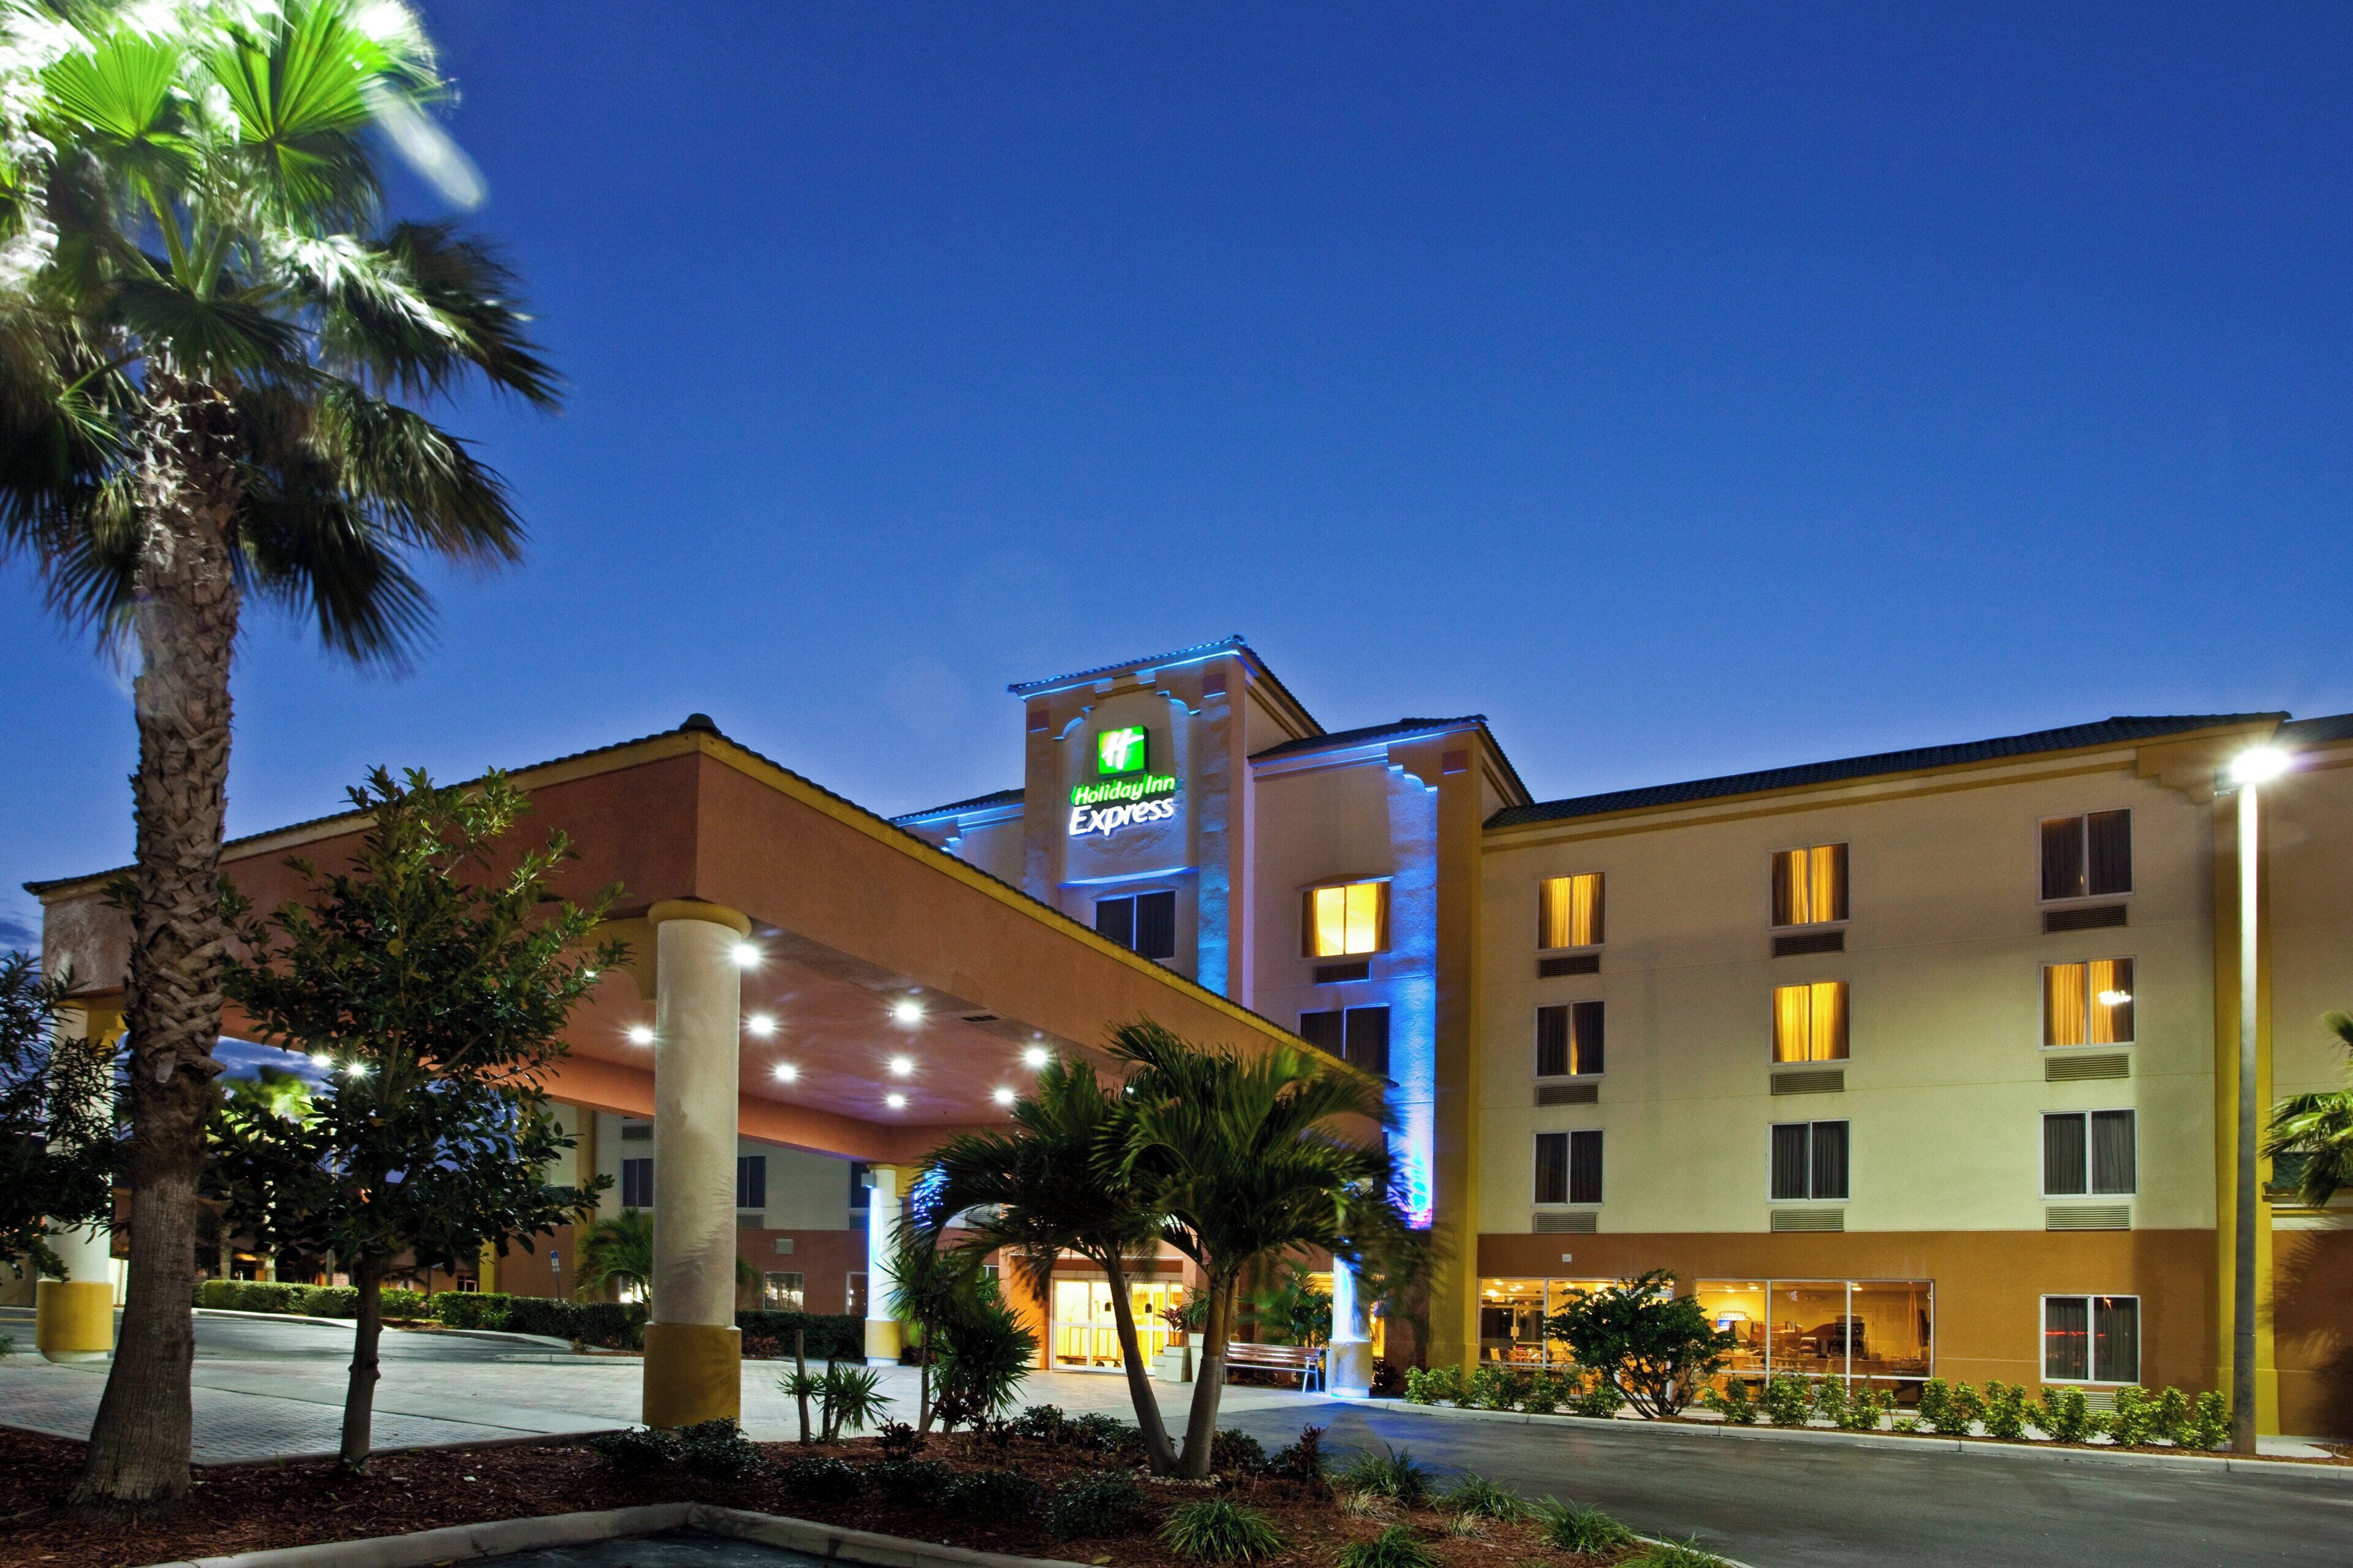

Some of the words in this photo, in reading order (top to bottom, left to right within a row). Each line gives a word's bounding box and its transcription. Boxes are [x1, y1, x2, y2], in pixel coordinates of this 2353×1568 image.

[1074, 780, 1143, 805] Holiday
[1145, 775, 1175, 794] Inn
[1069, 798, 1174, 836] Express
